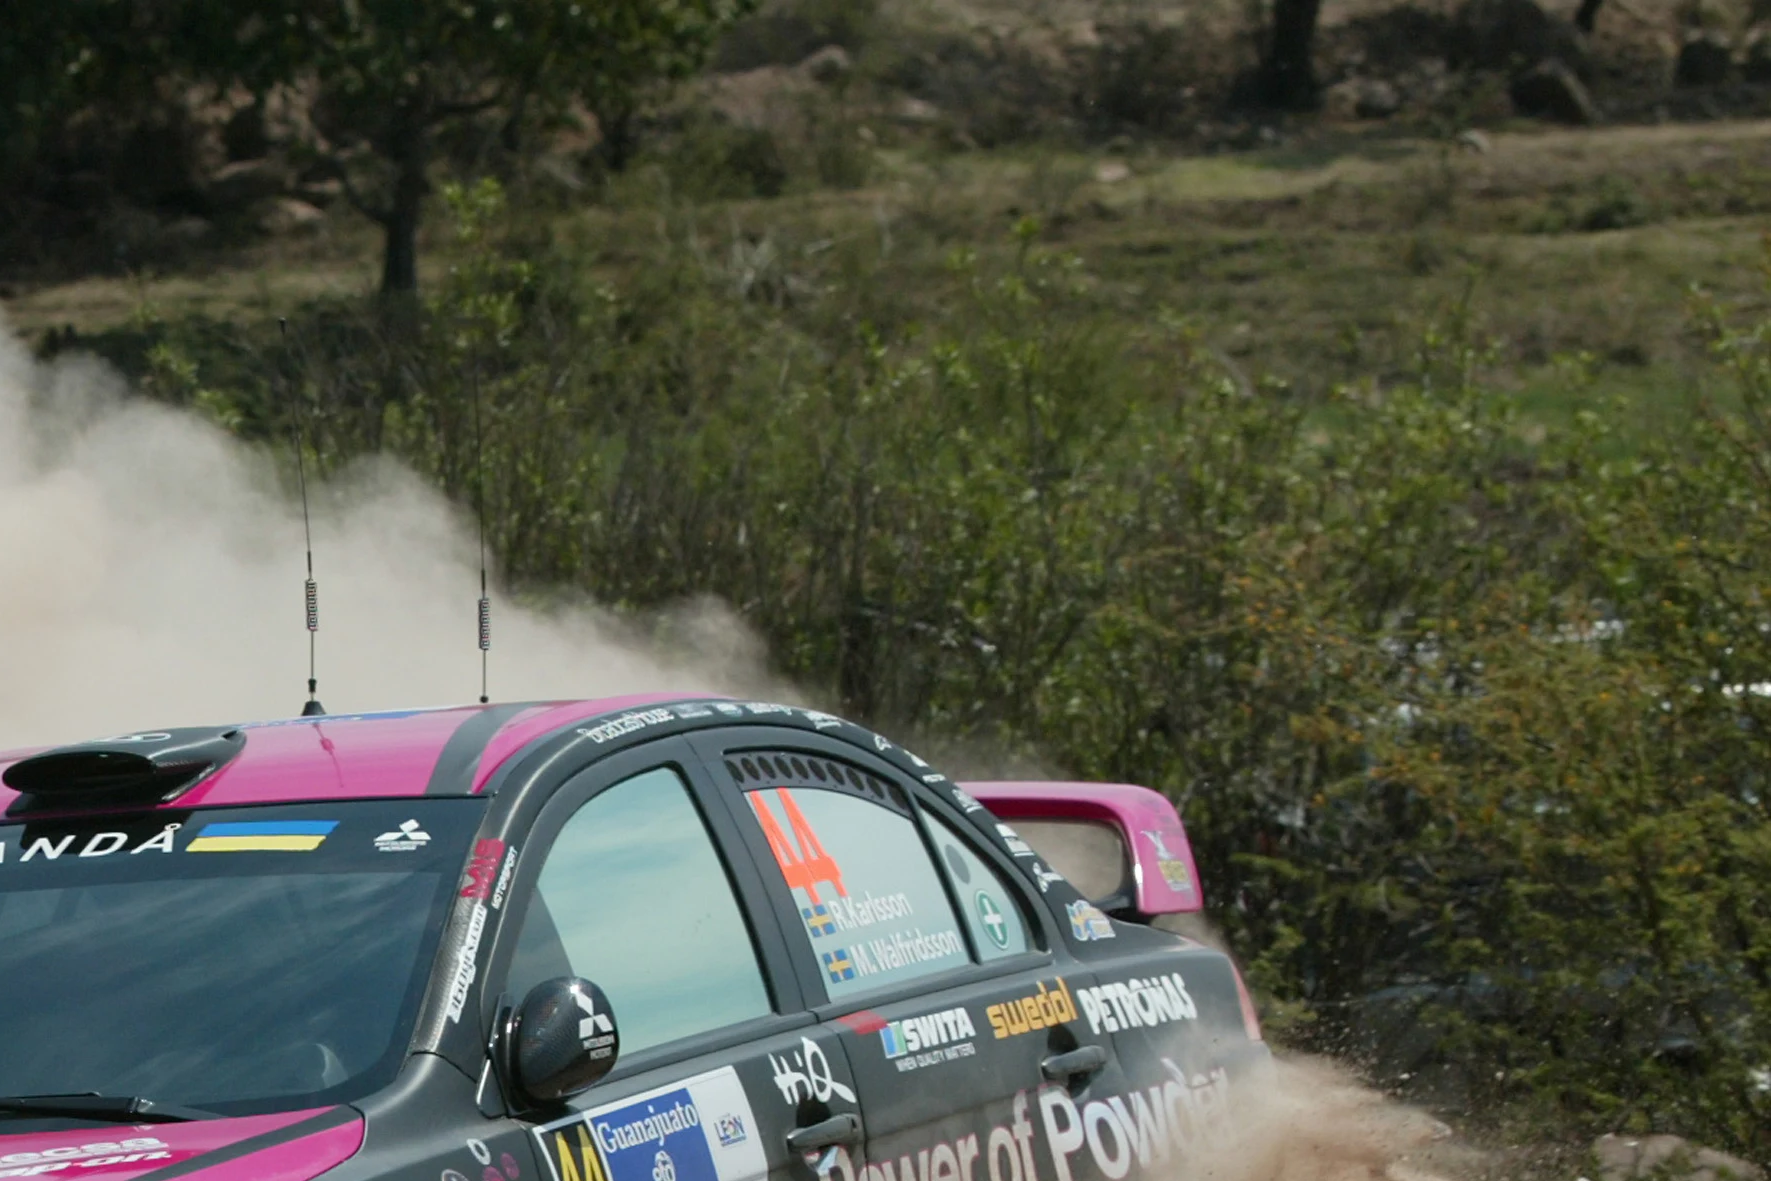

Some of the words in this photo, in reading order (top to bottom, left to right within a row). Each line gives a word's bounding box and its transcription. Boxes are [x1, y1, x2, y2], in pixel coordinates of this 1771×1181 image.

[748, 786, 849, 906] 44
[828, 890, 914, 932] R.Karlsson
[905, 1007, 976, 1053] SWITA
[986, 976, 1078, 1039] swedol
[1076, 972, 1198, 1036] PETRONAS
[596, 1101, 699, 1154] Guanajuato
